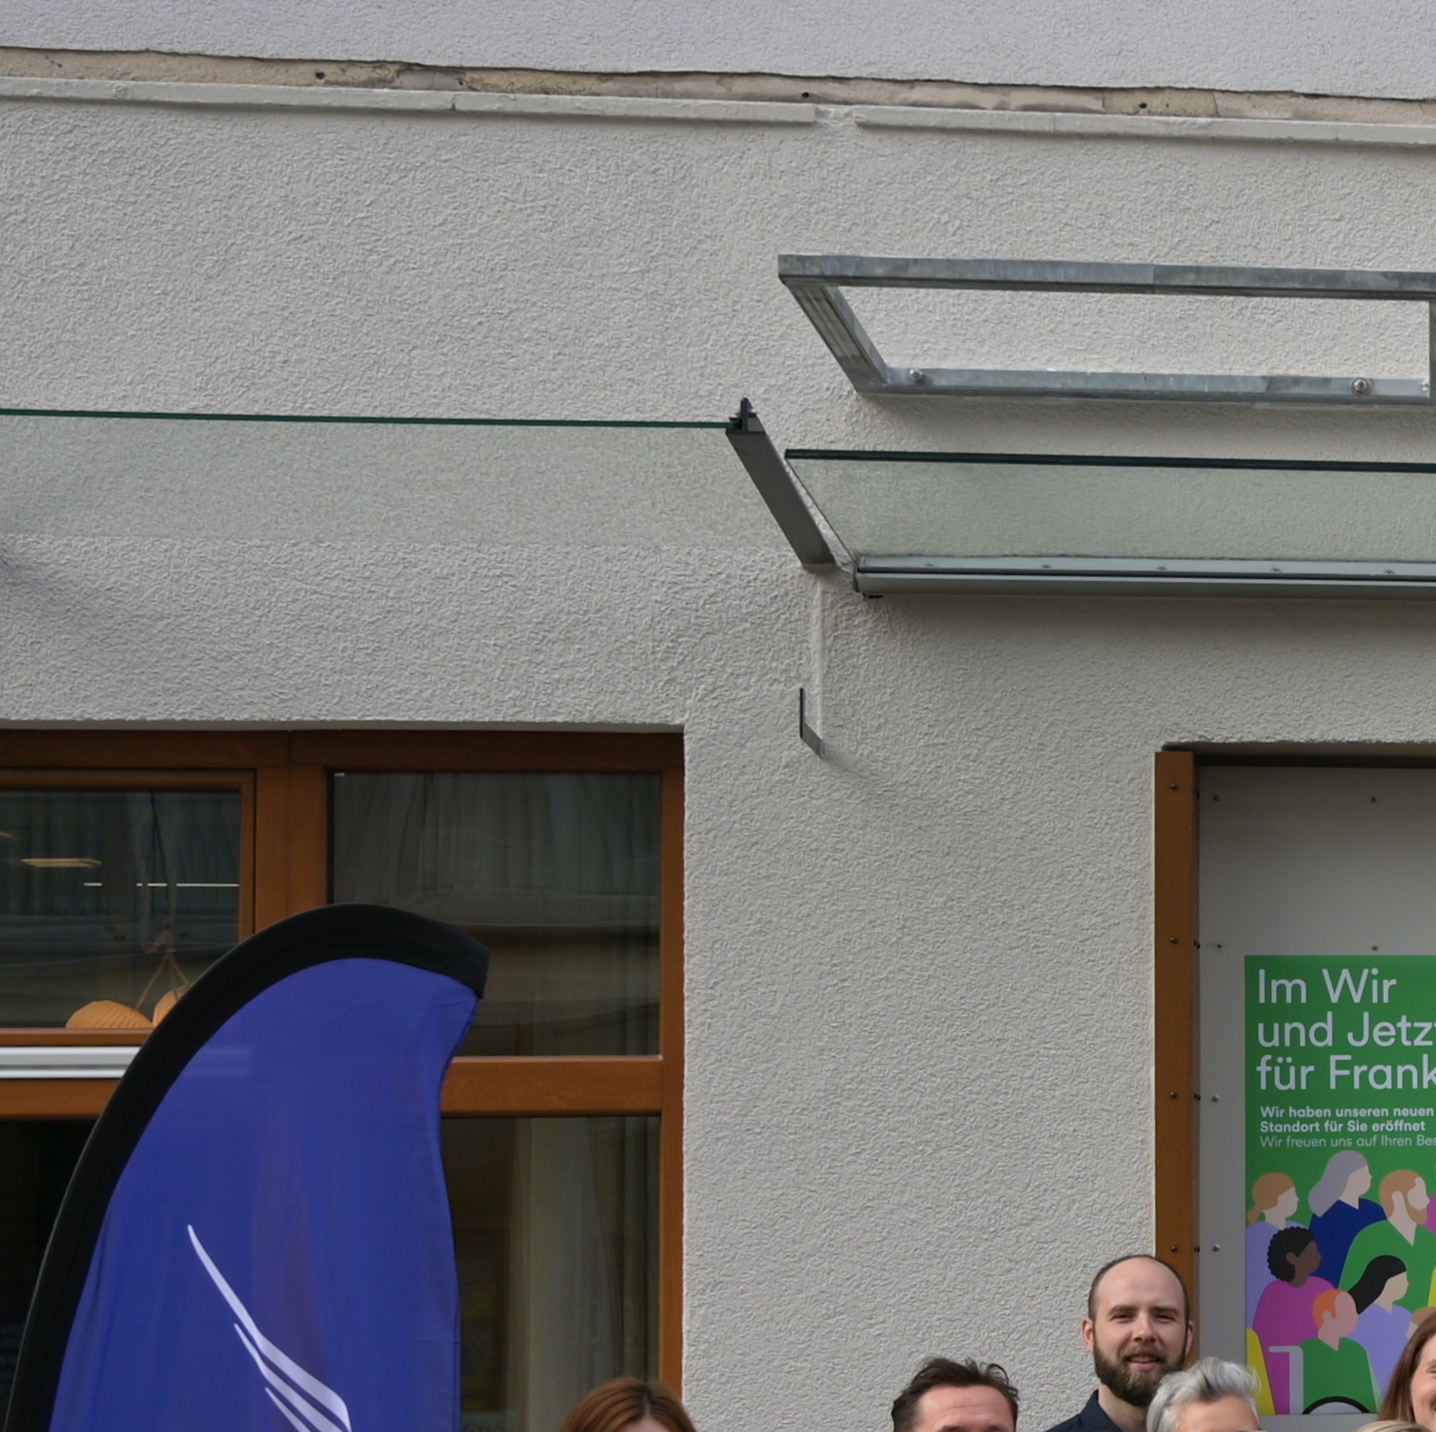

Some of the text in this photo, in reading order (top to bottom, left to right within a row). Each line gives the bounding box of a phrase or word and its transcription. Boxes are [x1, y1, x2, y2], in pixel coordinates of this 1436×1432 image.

[1258, 968, 1397, 1004] Im Wir
[1257, 1011, 1334, 1048] und
[1255, 1054, 1316, 1091] für
[1260, 1105, 1435, 1118] Wir haben unseren neuen
[1259, 1119, 1426, 1133] Standort für Sie eröffnet
[1259, 1135, 1283, 1148] Wir
[1285, 1134, 1327, 1148] freuen
[1330, 1137, 1353, 1148] uns
[1355, 1134, 1379, 1148] auf
[1380, 1134, 1413, 1147] Ihren
